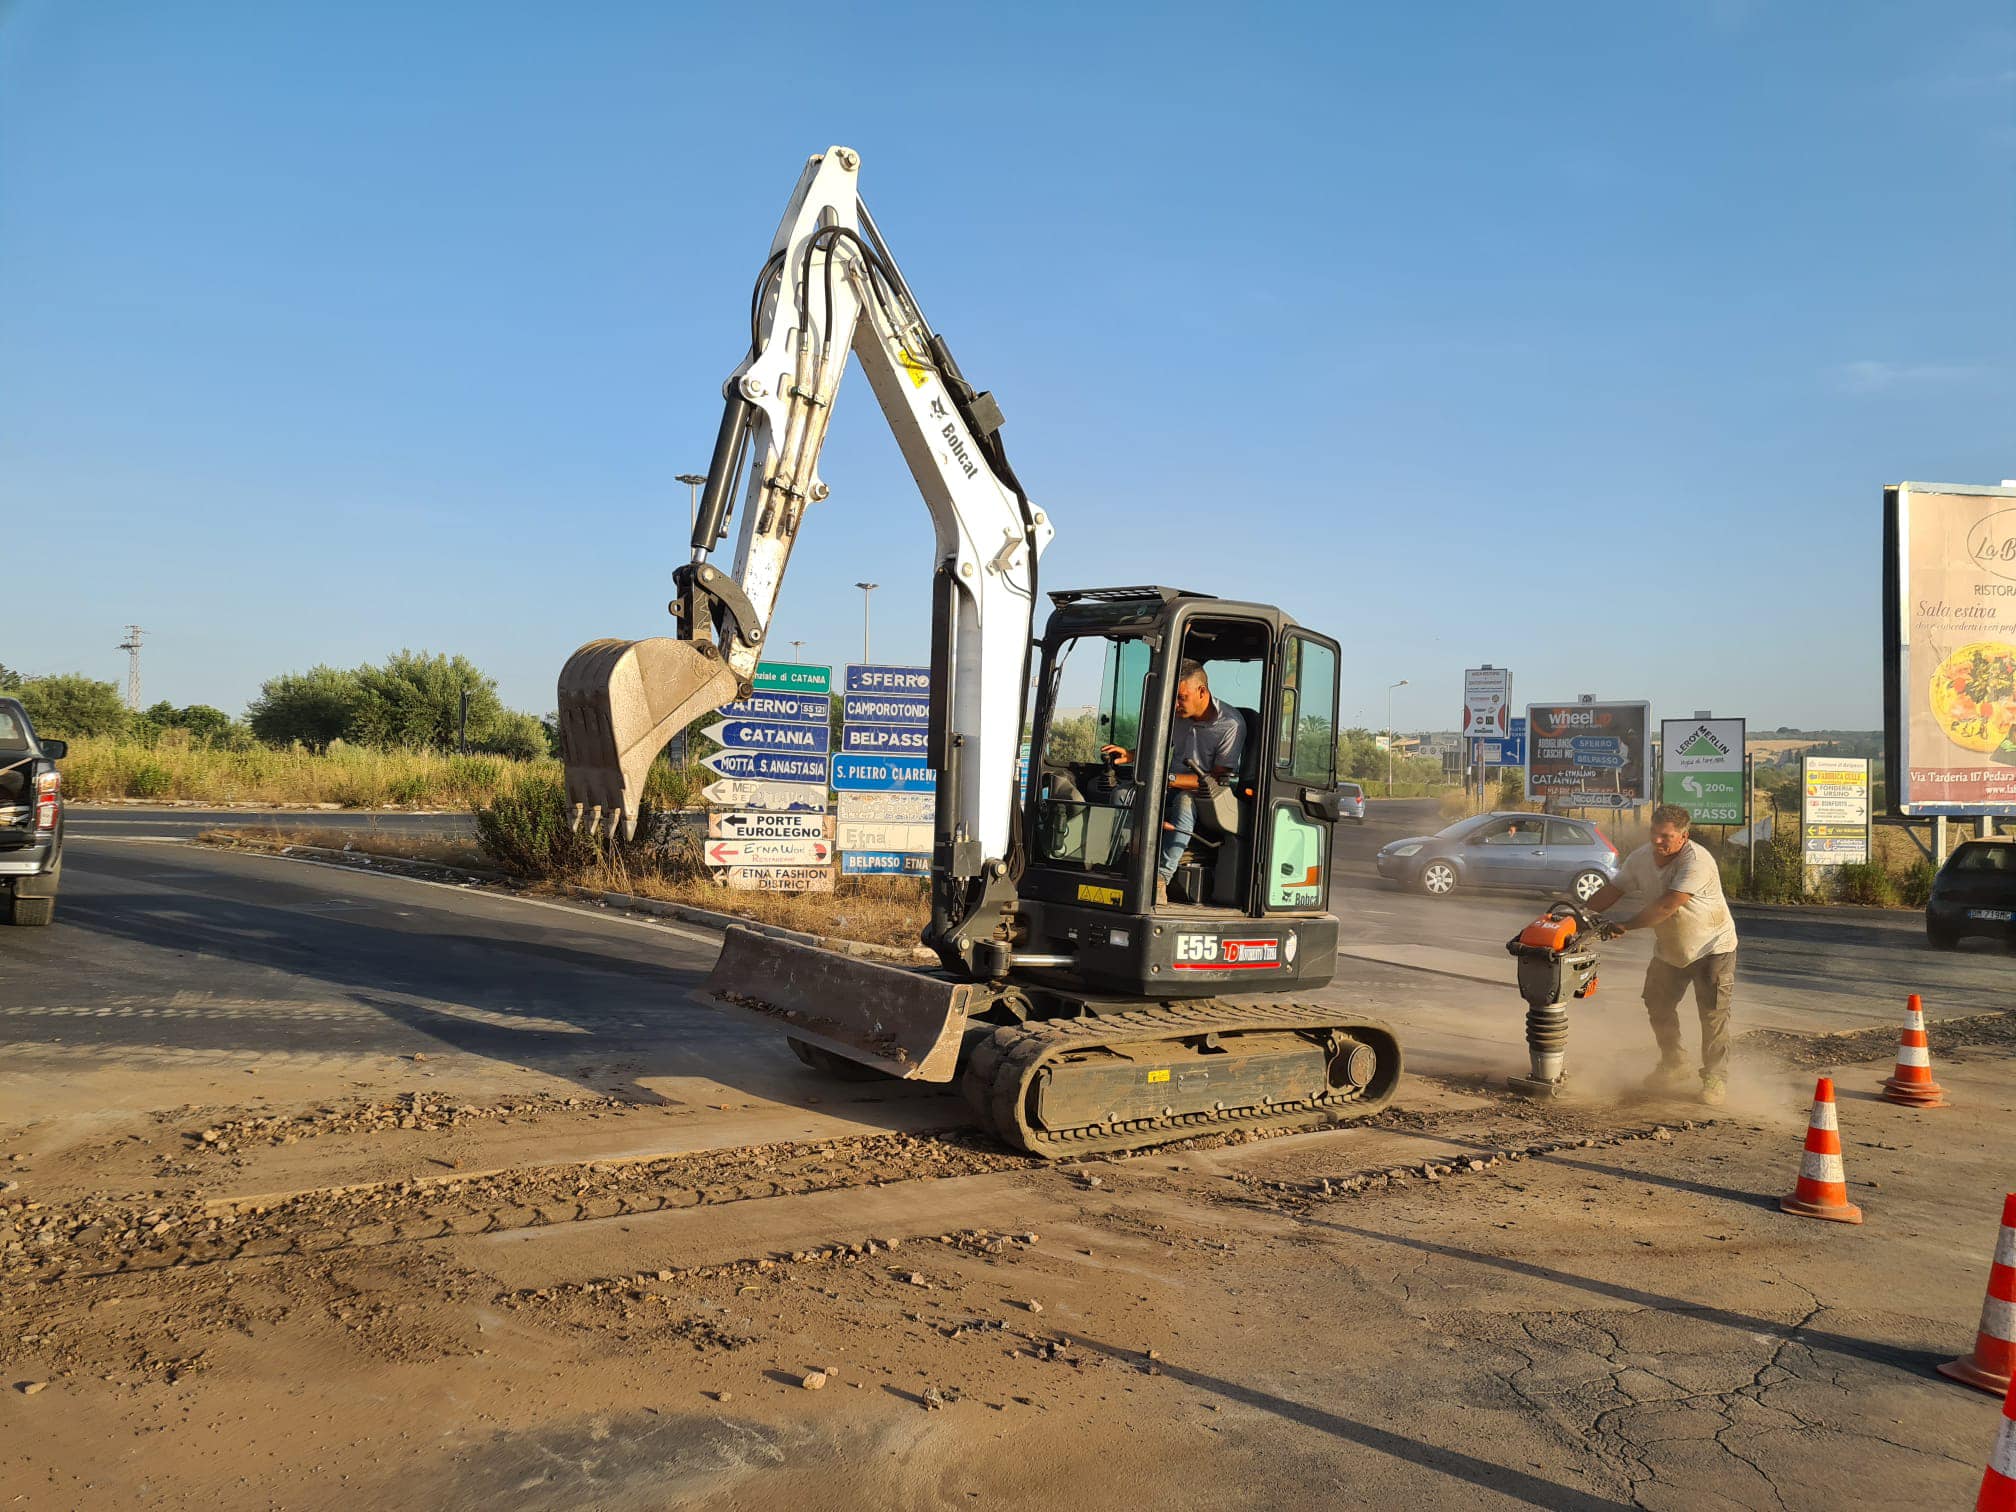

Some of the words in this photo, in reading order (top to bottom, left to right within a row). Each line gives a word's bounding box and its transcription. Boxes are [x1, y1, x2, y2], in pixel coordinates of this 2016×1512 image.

[942, 422, 978, 479] Bobcat
[1975, 537, 1999, 560] La
[1917, 600, 1951, 618] Sala
[1954, 603, 1997, 618] estiva
[754, 671, 777, 681] nziale
[780, 672, 787, 681] di
[791, 673, 826, 685] CATANIA
[861, 672, 930, 688] SFERRO
[740, 727, 814, 745] CATANIA
[1675, 730, 1700, 755] LEROY
[1698, 725, 1730, 755] MERLIN
[721, 757, 755, 772] MOTTA
[837, 766, 846, 779] S.
[849, 765, 888, 780] PIETRO
[892, 766, 937, 781] CLARENZ
[1910, 772, 1926, 782] Via
[1928, 771, 1968, 783] Tarderia
[1983, 771, 2015, 782] Pedara
[757, 816, 802, 826] PORTE
[1692, 809, 1737, 820] PASSO
[737, 827, 821, 838] EUROLEGNO
[849, 855, 901, 868] BELPASSO
[905, 857, 929, 870] ETNA
[742, 868, 772, 879] ETNA
[776, 869, 828, 880] FASHION
[759, 879, 811, 889] DISTRICT
[1295, 892, 1320, 907] Bobca
[1176, 935, 1218, 961] E55
